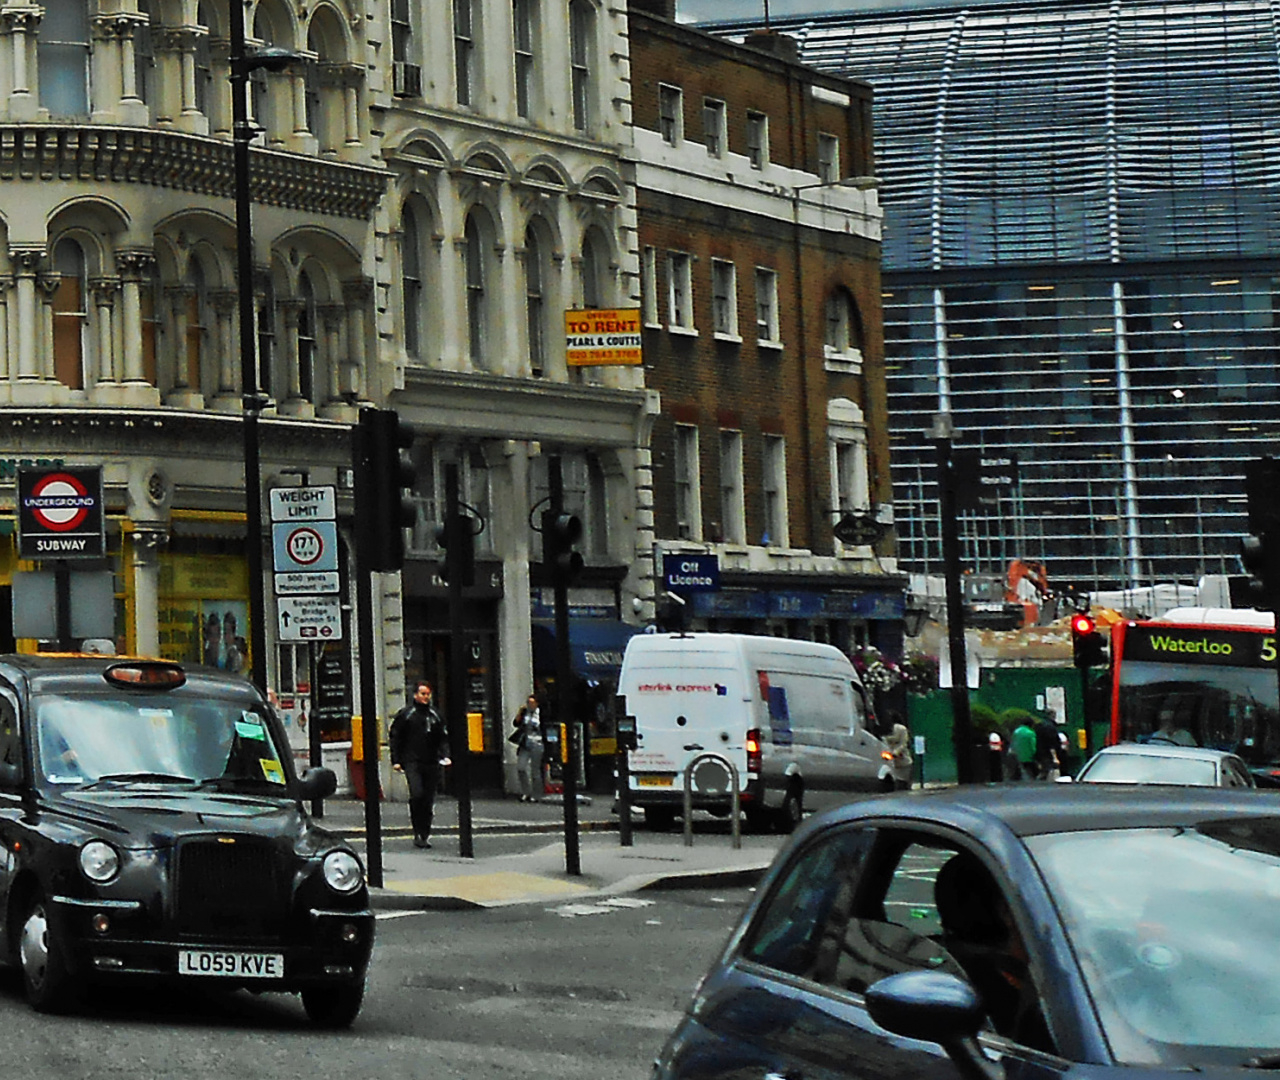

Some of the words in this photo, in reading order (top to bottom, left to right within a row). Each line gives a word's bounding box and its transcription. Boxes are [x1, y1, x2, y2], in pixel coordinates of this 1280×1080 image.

[569, 322, 590, 333] TO
[595, 320, 636, 332] RENT
[567, 337, 595, 347] PEARL
[598, 336, 604, 346] &
[607, 336, 640, 346] COUTTS
[24, 497, 94, 507] UNDERGROUND
[279, 490, 325, 503] WEIGHT
[288, 506, 318, 517] LIMIT
[37, 540, 86, 551] SUBWAY
[681, 562, 699, 573] Off
[669, 575, 712, 585] Licence
[302, 608, 327, 616] Bridge
[1150, 635, 1232, 655] Waterloo
[676, 685, 710, 693] express
[187, 953, 236, 972] LO59
[241, 954, 276, 974] KVE
